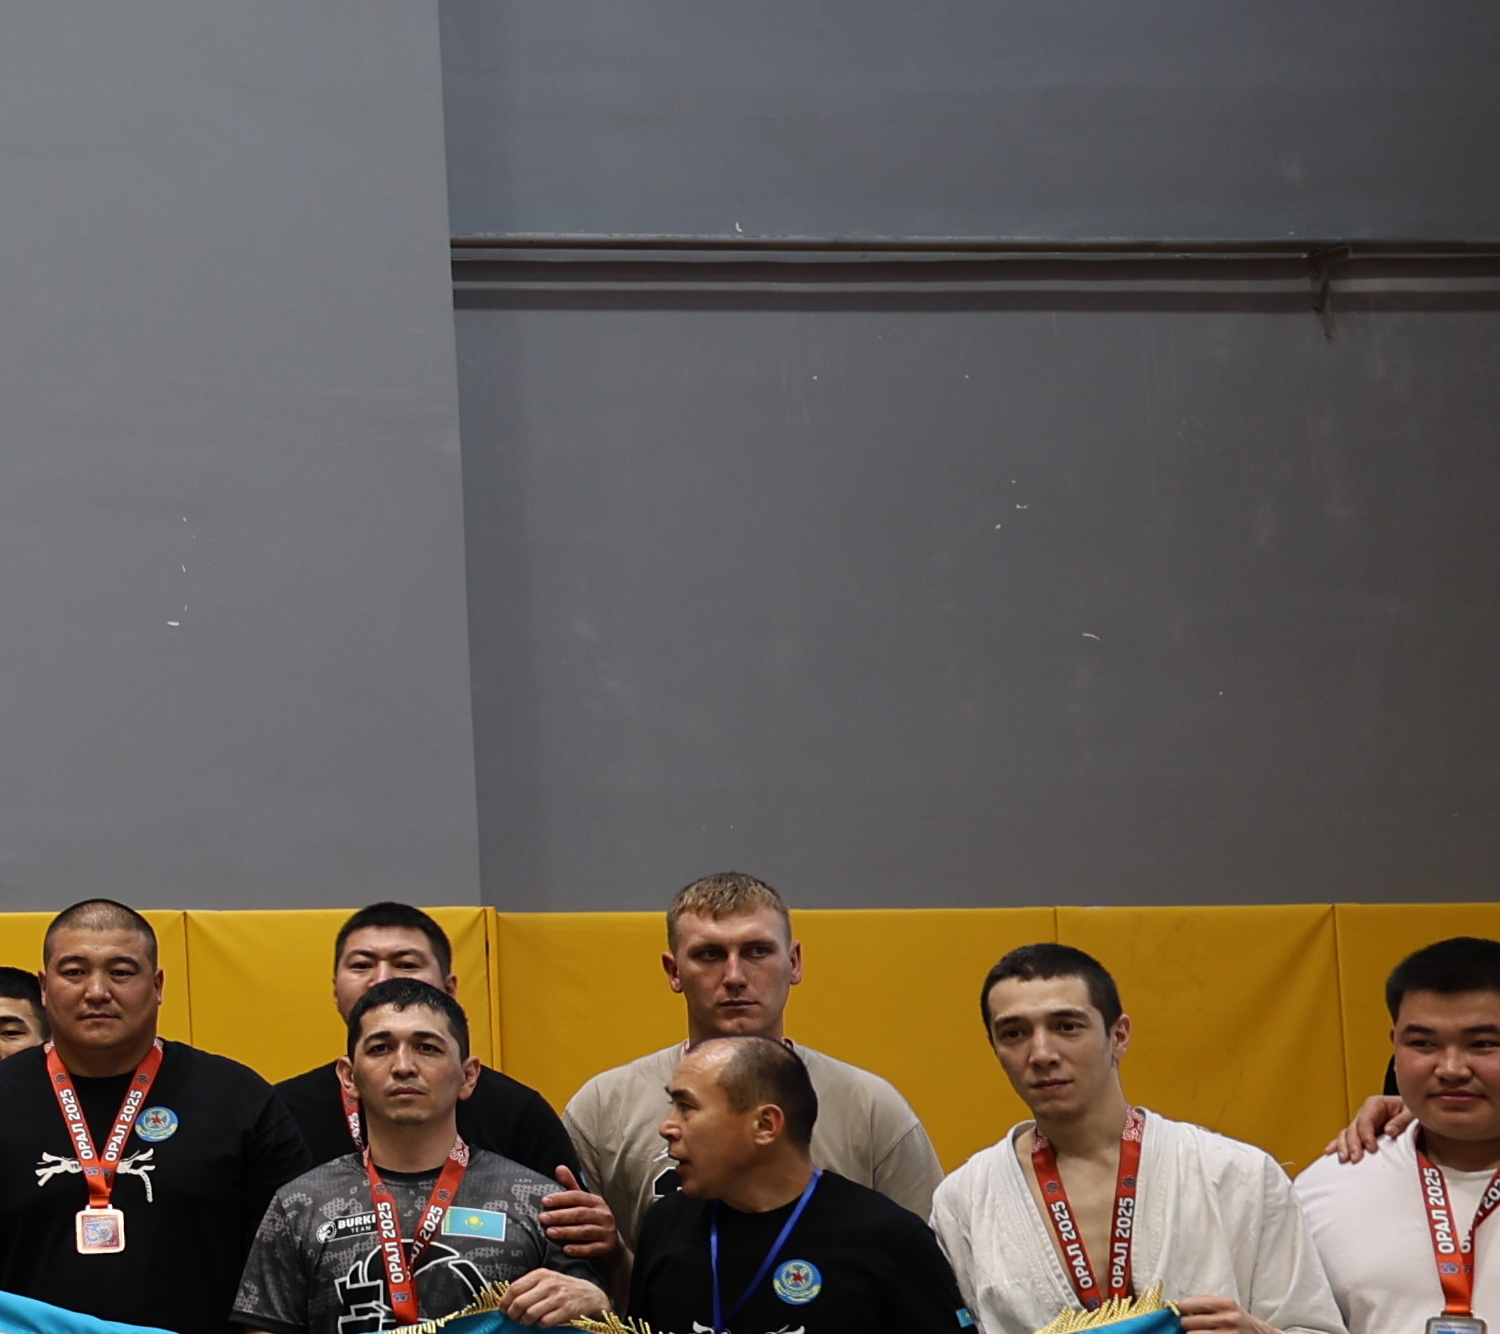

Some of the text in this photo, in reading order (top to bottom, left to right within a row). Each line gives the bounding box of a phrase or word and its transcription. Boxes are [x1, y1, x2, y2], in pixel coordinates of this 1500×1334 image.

[59, 1088, 94, 1160] ОРАЛ 2025
[105, 1090, 143, 1162] ОРАЛ 2025
[337, 1214, 376, 1231] BURKI
[351, 1224, 372, 1234] TEAM
[418, 1204, 444, 1241] 2025
[1423, 1167, 1455, 1254] ОРАЛ 2025
[1482, 1178, 1500, 1210] 202
[376, 1201, 405, 1284] ОРАЛ 2025
[1050, 1200, 1093, 1289] ОРАЛ 2025
[1111, 1197, 1134, 1288] ОРАЛ 2025
